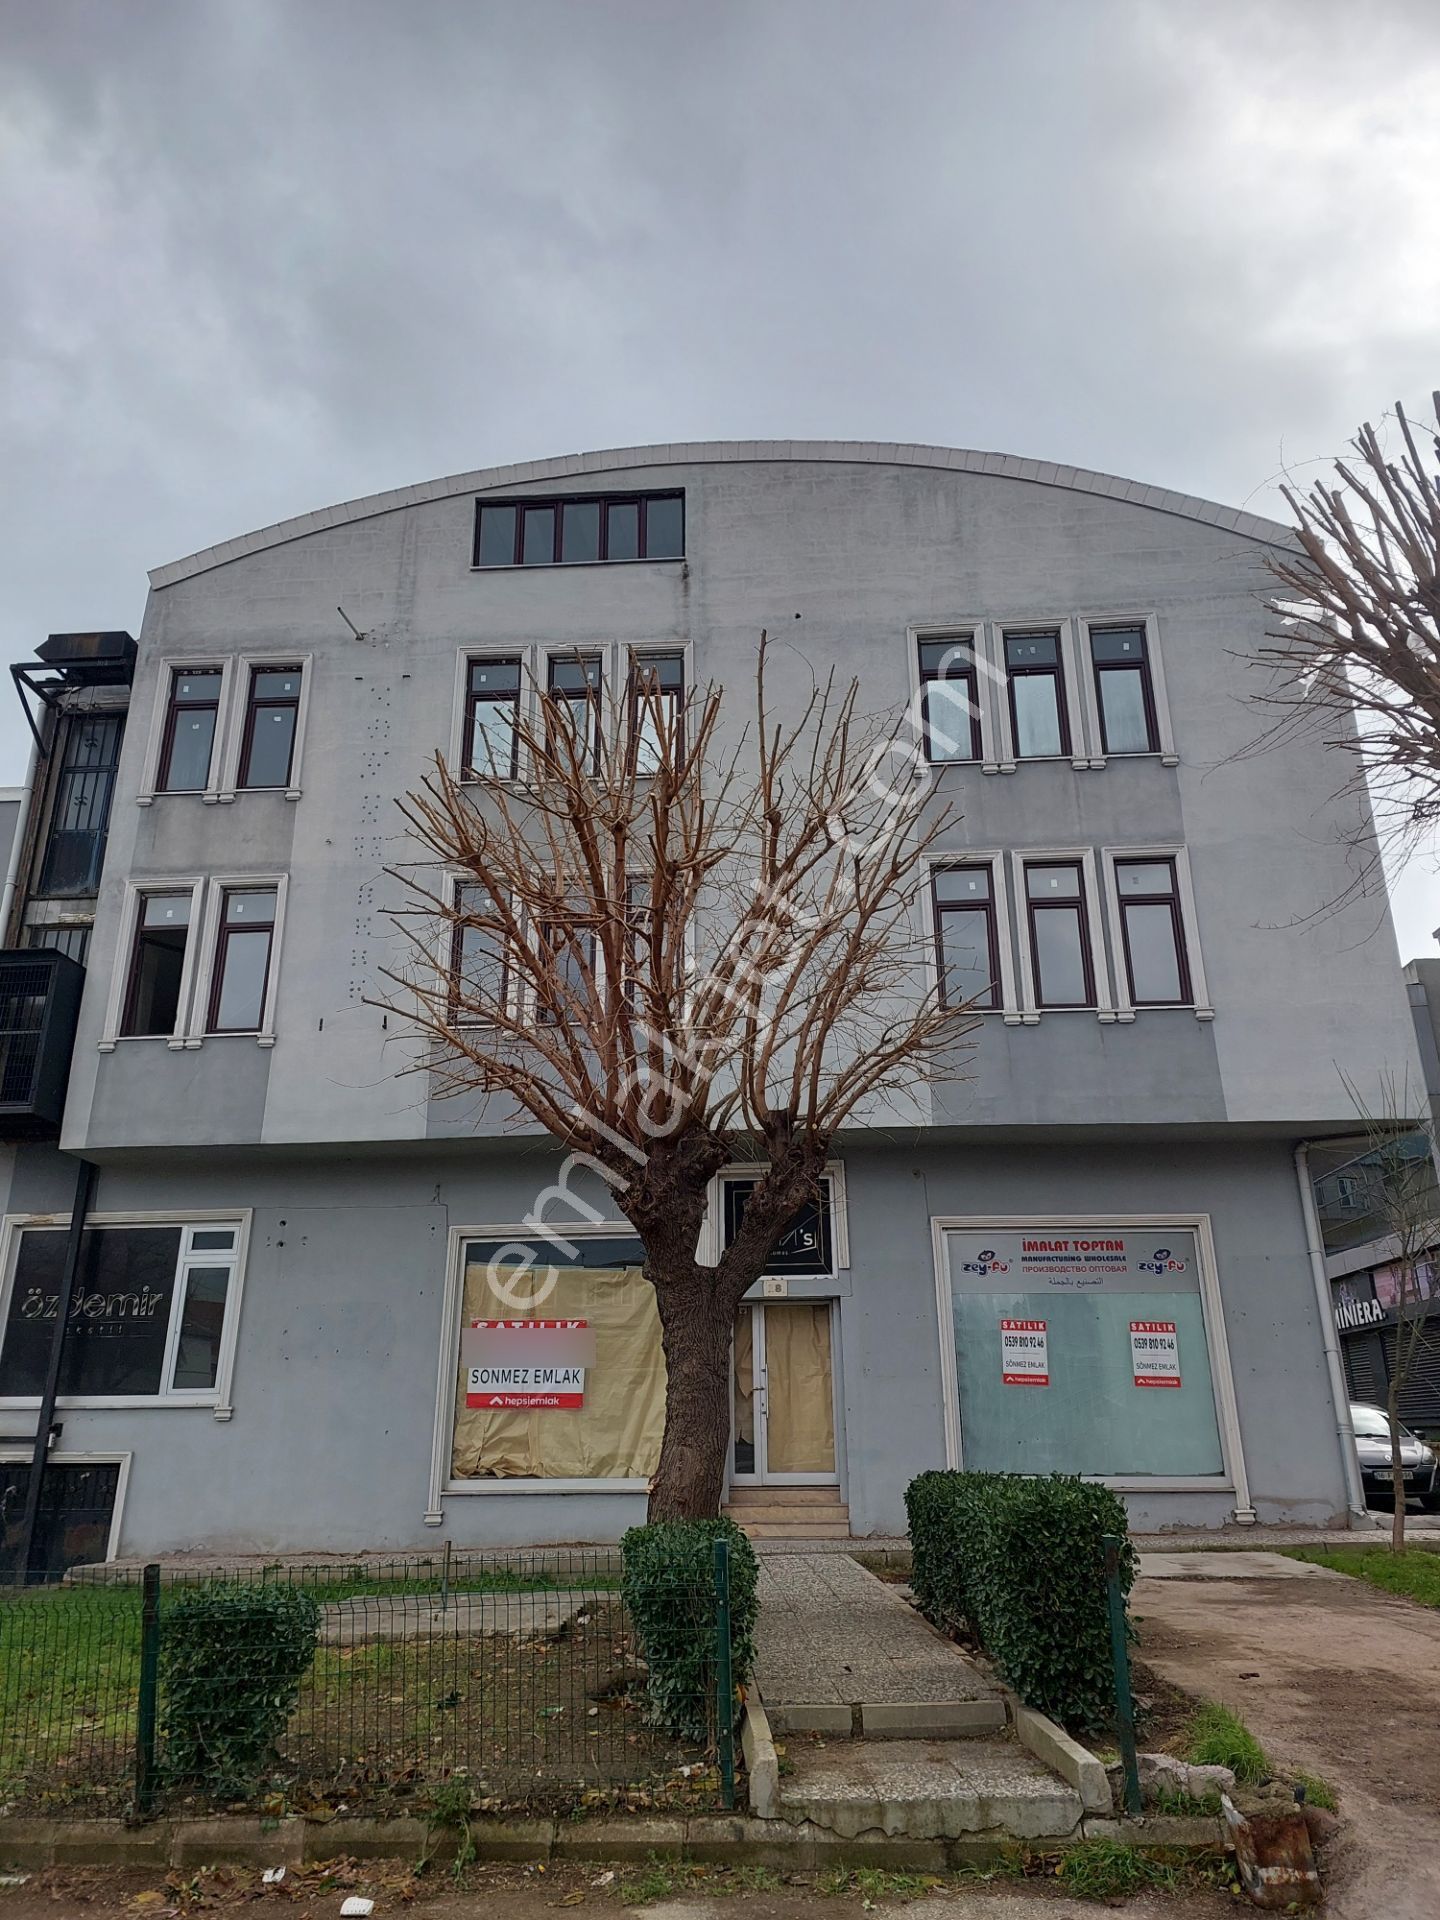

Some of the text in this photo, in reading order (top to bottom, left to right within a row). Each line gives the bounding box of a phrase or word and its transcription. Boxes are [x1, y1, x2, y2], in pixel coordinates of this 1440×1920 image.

[1022, 1238, 1124, 1252] İMALAT TOPTAN
[1022, 1265, 1127, 1273] ПРОИЗВОДСТВО ОПТОВАЯ
[21, 1285, 163, 1318] özdemir
[1002, 1321, 1045, 1330] SATILIK
[1131, 1322, 1174, 1331] SATILIK
[1004, 1336, 1018, 1347] 0539
[1030, 1337, 1037, 1348] 92
[1134, 1338, 1175, 1350] 0539 810 92 46
[534, 1369, 580, 1384] EMLAK
